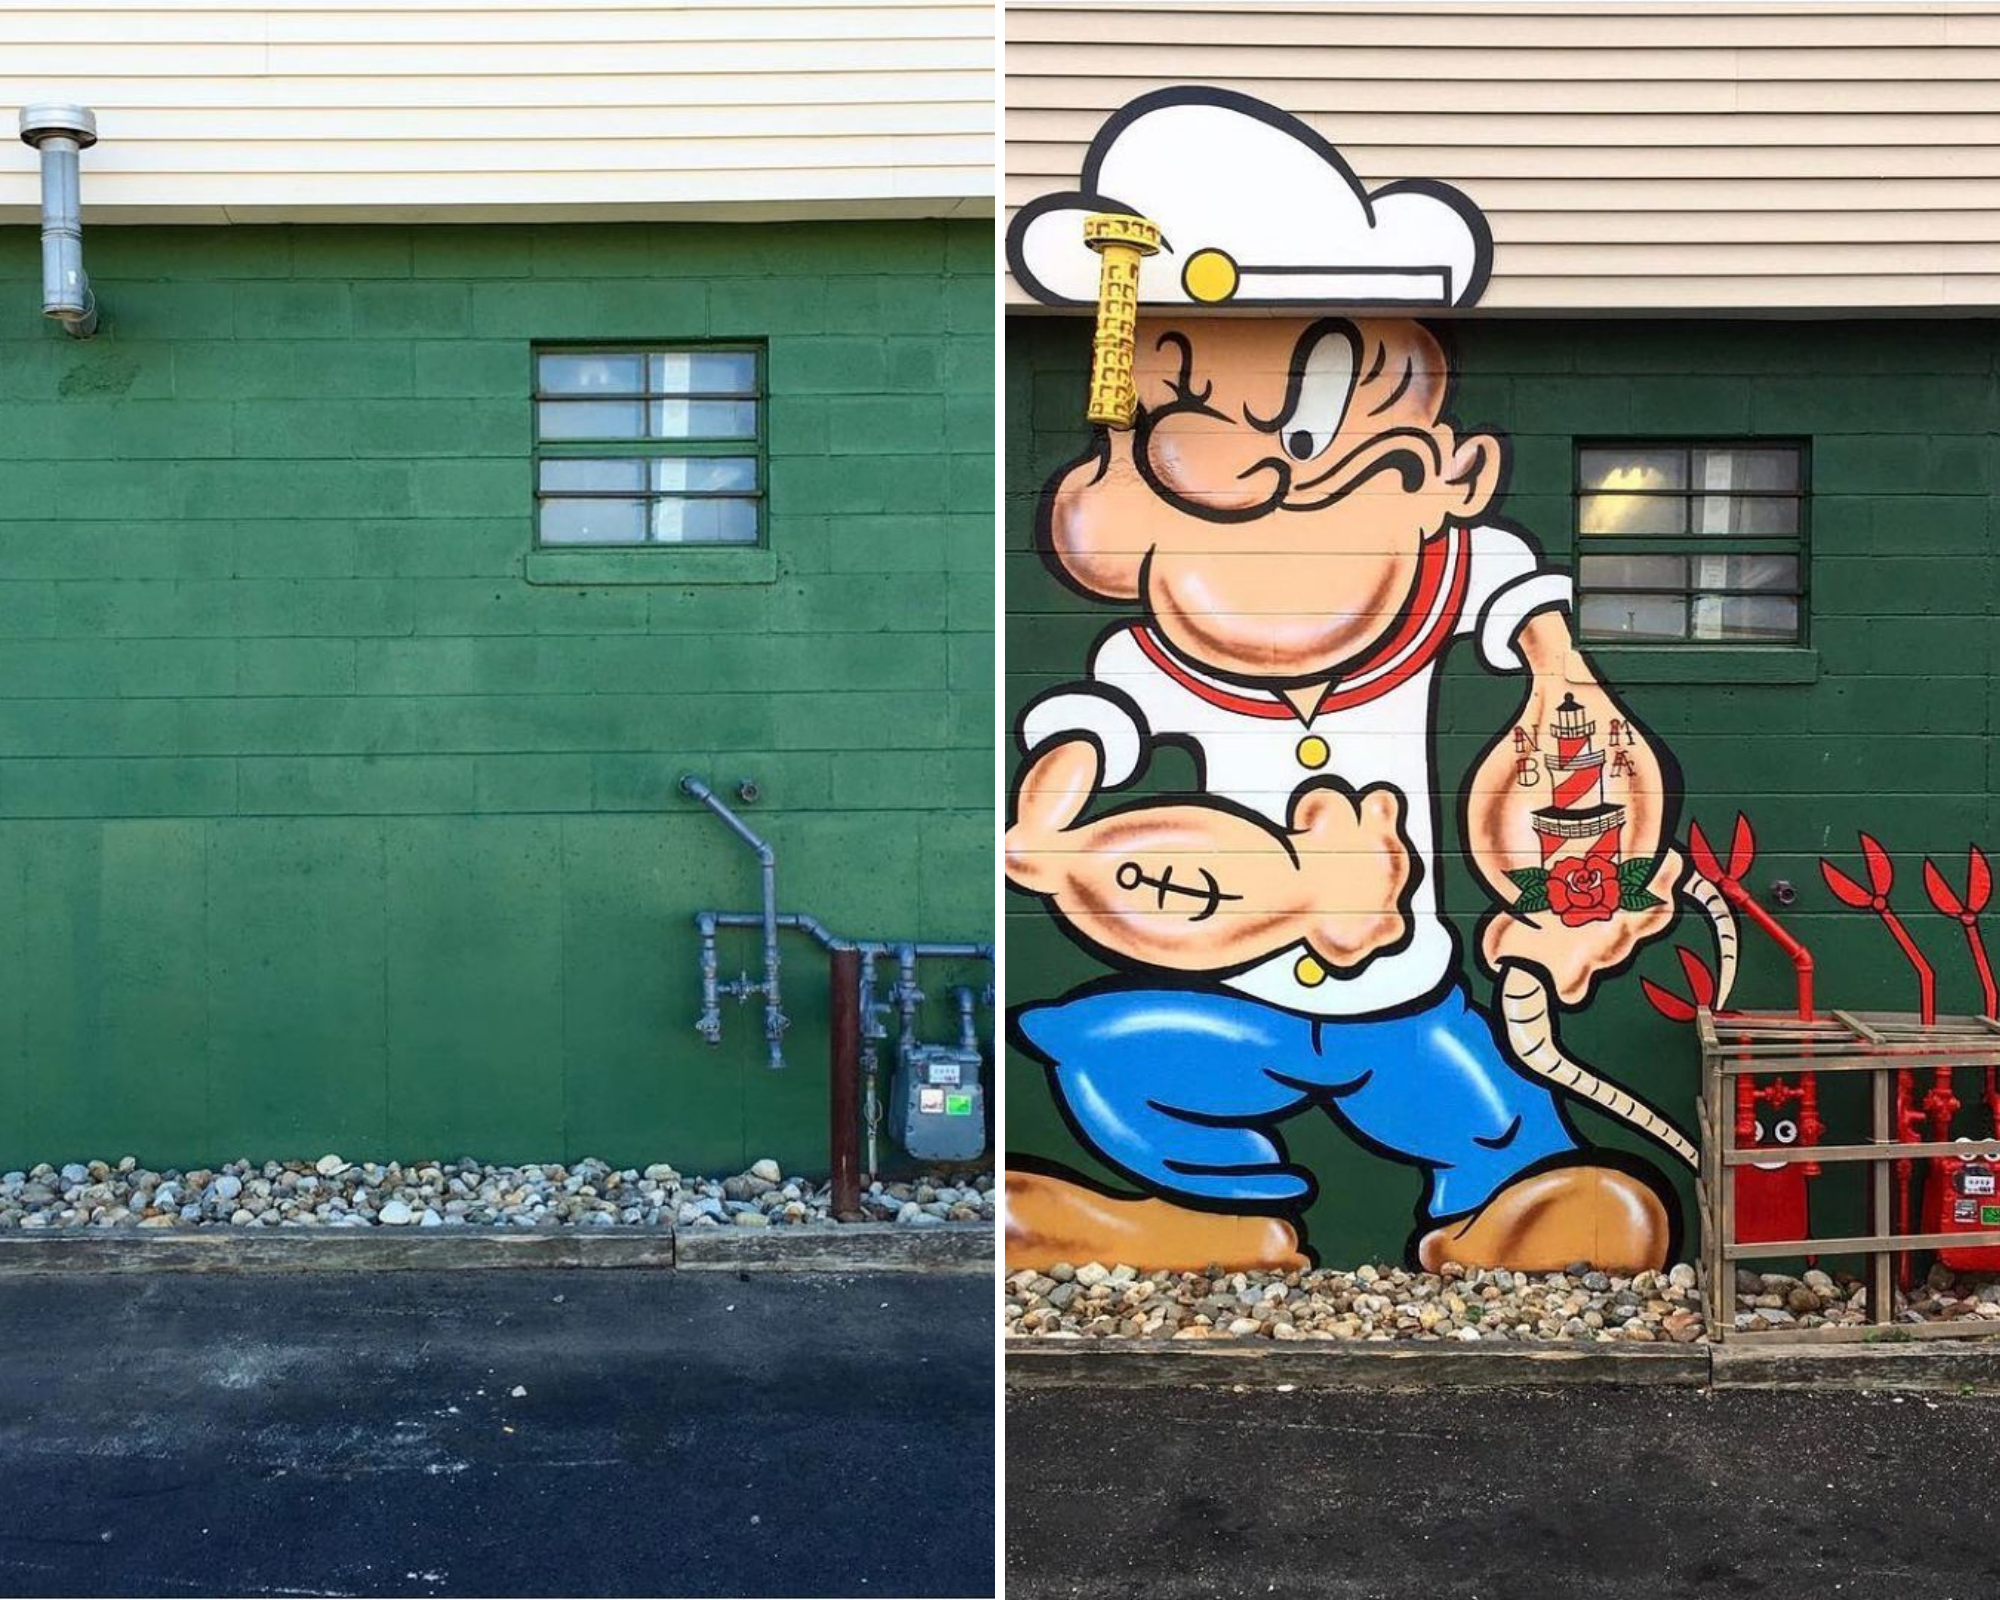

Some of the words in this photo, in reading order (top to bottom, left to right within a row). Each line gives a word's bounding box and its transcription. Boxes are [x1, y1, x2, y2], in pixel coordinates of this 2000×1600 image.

[1513, 724, 1540, 753] N
[1609, 718, 1636, 747] M
[1516, 757, 1540, 787] B
